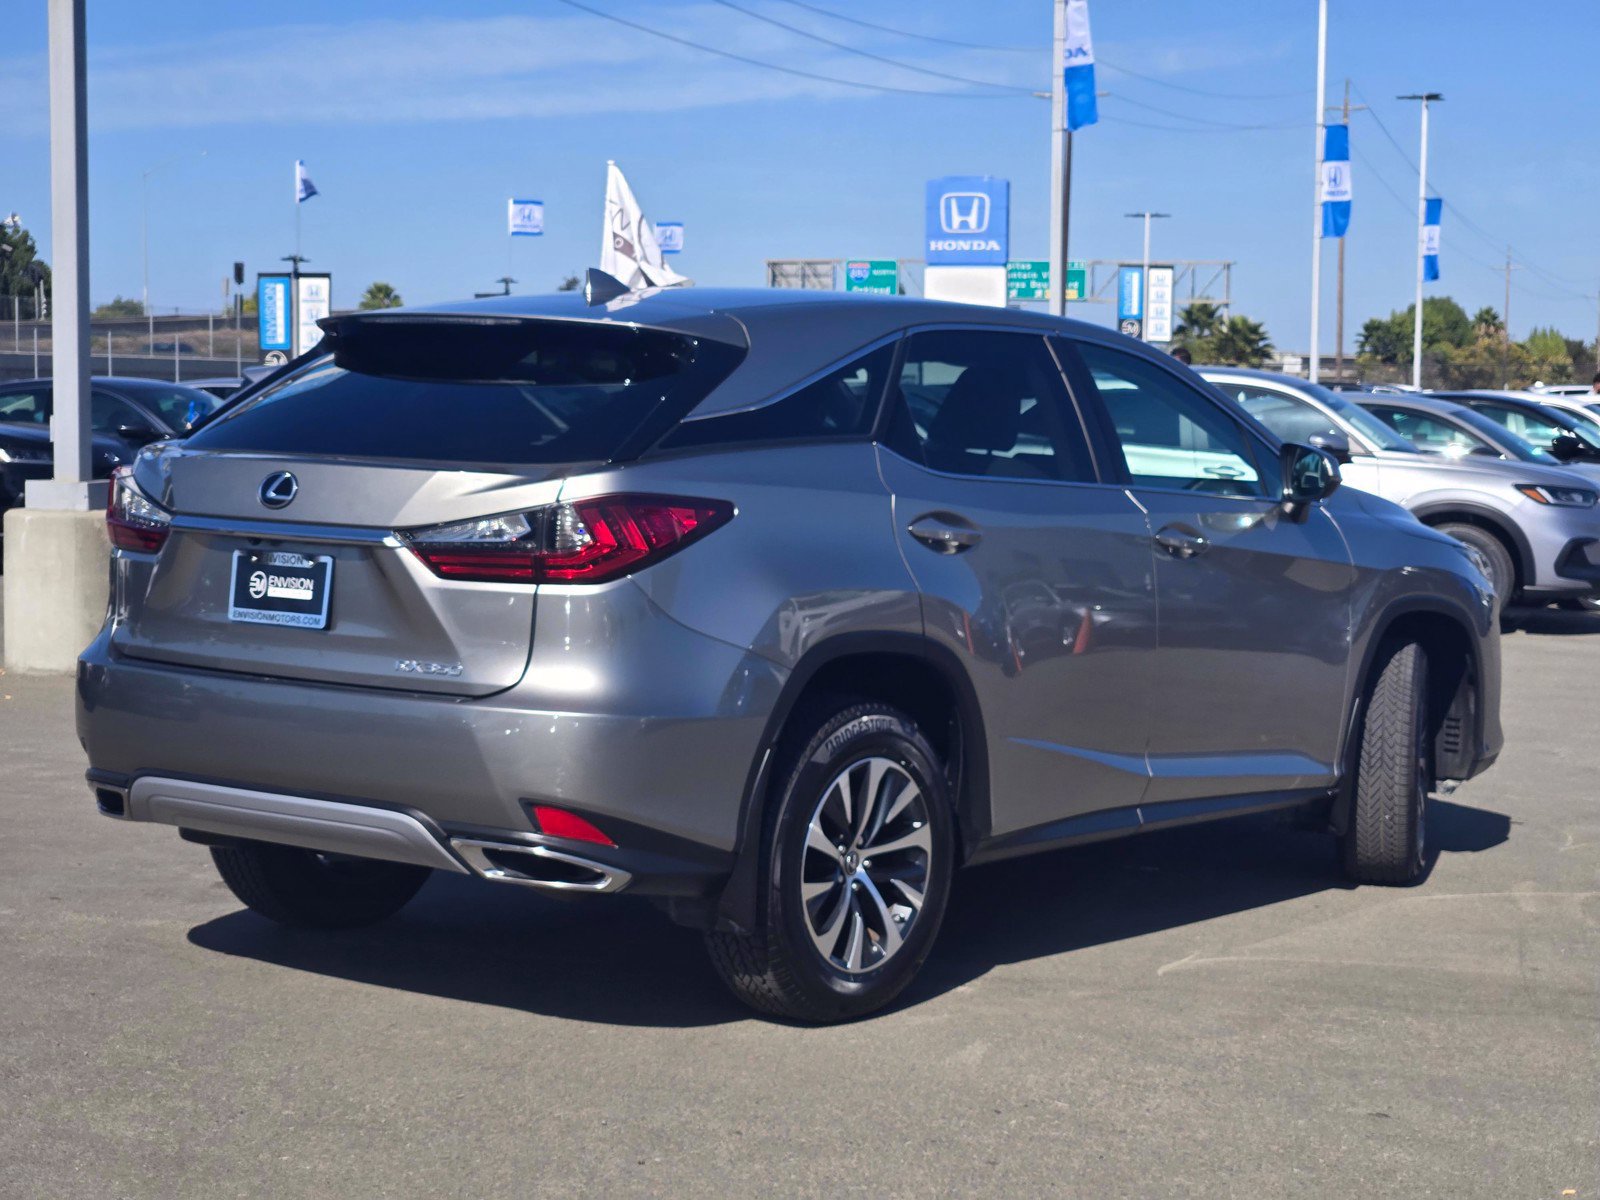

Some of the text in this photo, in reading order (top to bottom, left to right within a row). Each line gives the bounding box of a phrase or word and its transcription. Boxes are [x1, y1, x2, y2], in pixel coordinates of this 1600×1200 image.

[929, 240, 1000, 251] HONDA
[268, 574, 314, 590] ENVISION
[232, 609, 321, 625] ENVISIONMOTORS.COM
